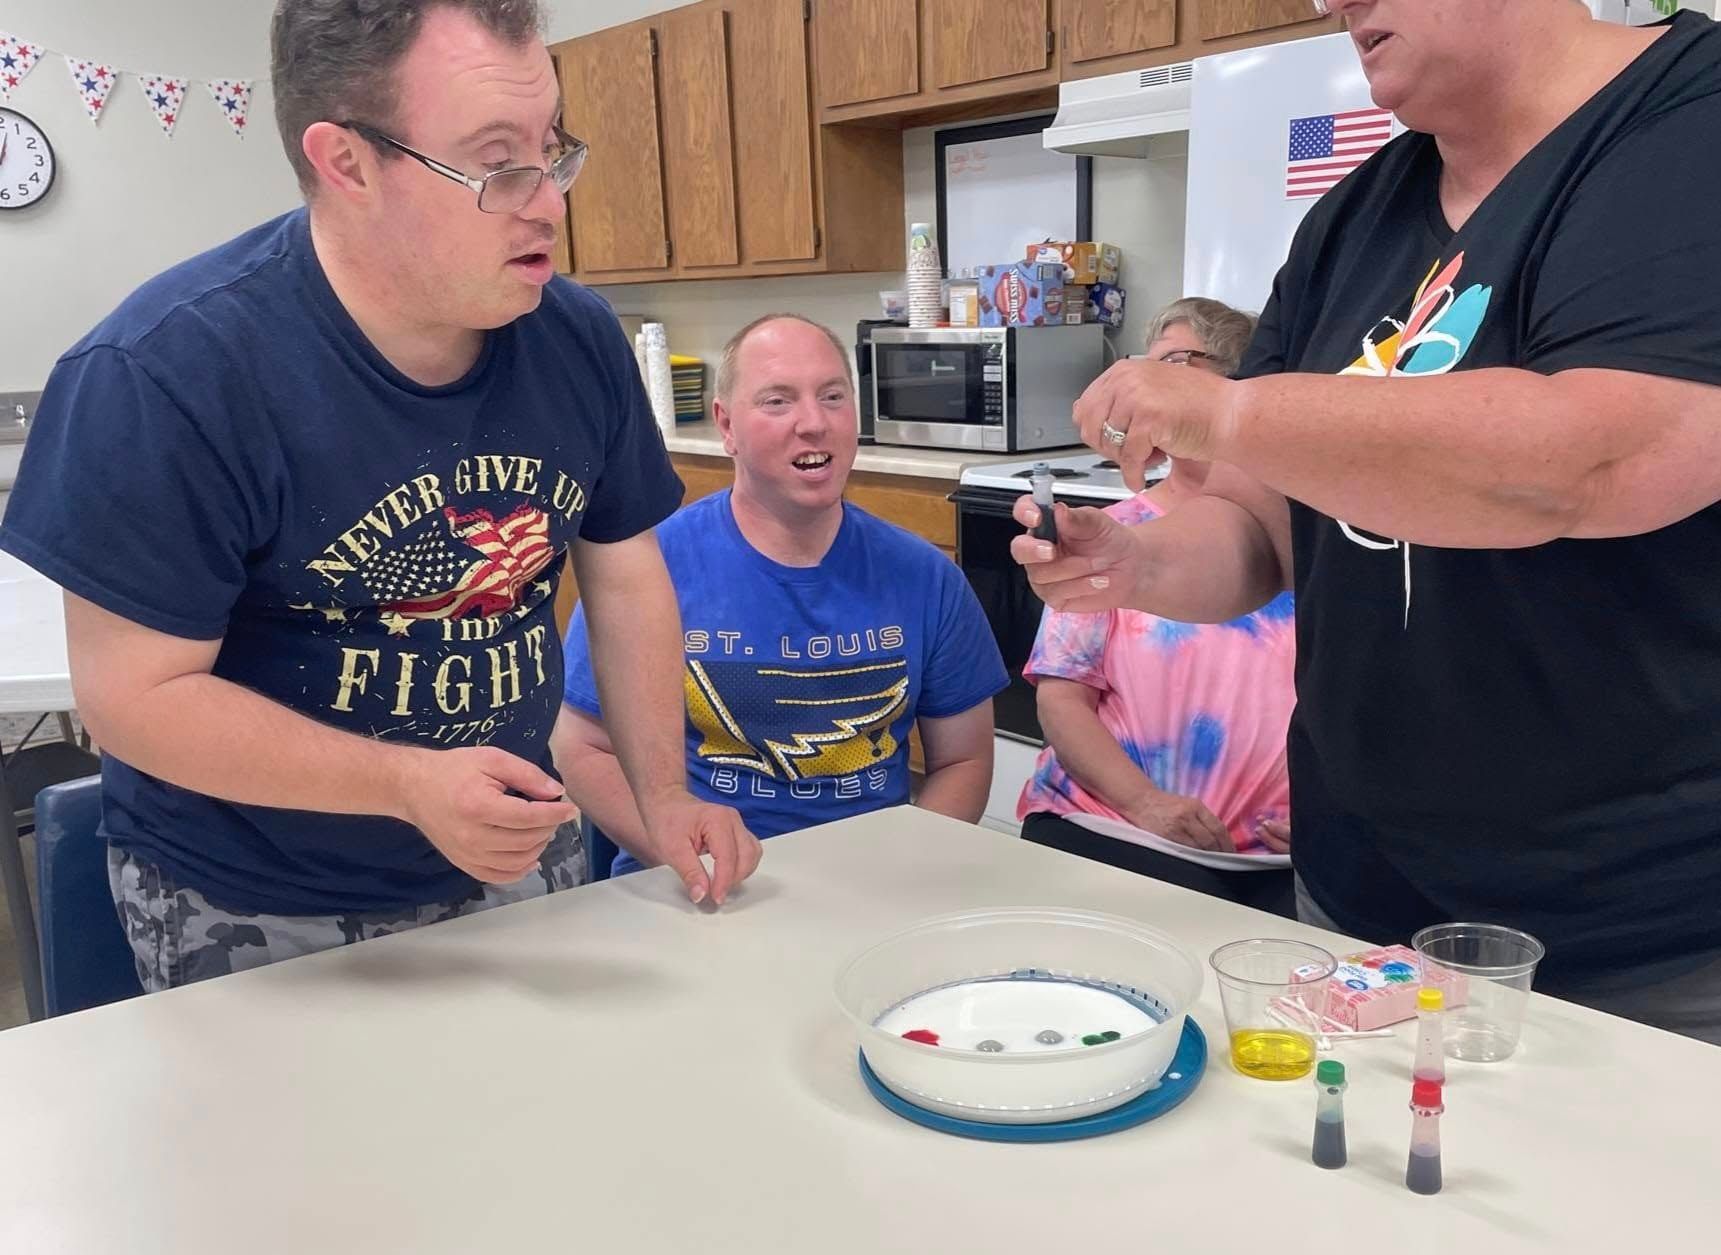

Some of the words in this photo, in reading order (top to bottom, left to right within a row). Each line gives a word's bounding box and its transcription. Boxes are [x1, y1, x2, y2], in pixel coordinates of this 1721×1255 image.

[14, 123, 20, 135] 1
[26, 137, 37, 150] 2
[34, 154, 44, 167] 3
[29, 172, 40, 184] 4
[0, 188, 11, 200] 6
[18, 183, 29, 196] 5
[305, 473, 446, 588] NEVER
[455, 454, 543, 496] GIVE
[552, 470, 587, 521] UP
[684, 629, 754, 656] ST.
[781, 625, 904, 660] LOUIS
[329, 625, 547, 717] FIGHT
[710, 766, 889, 800] BLUES
